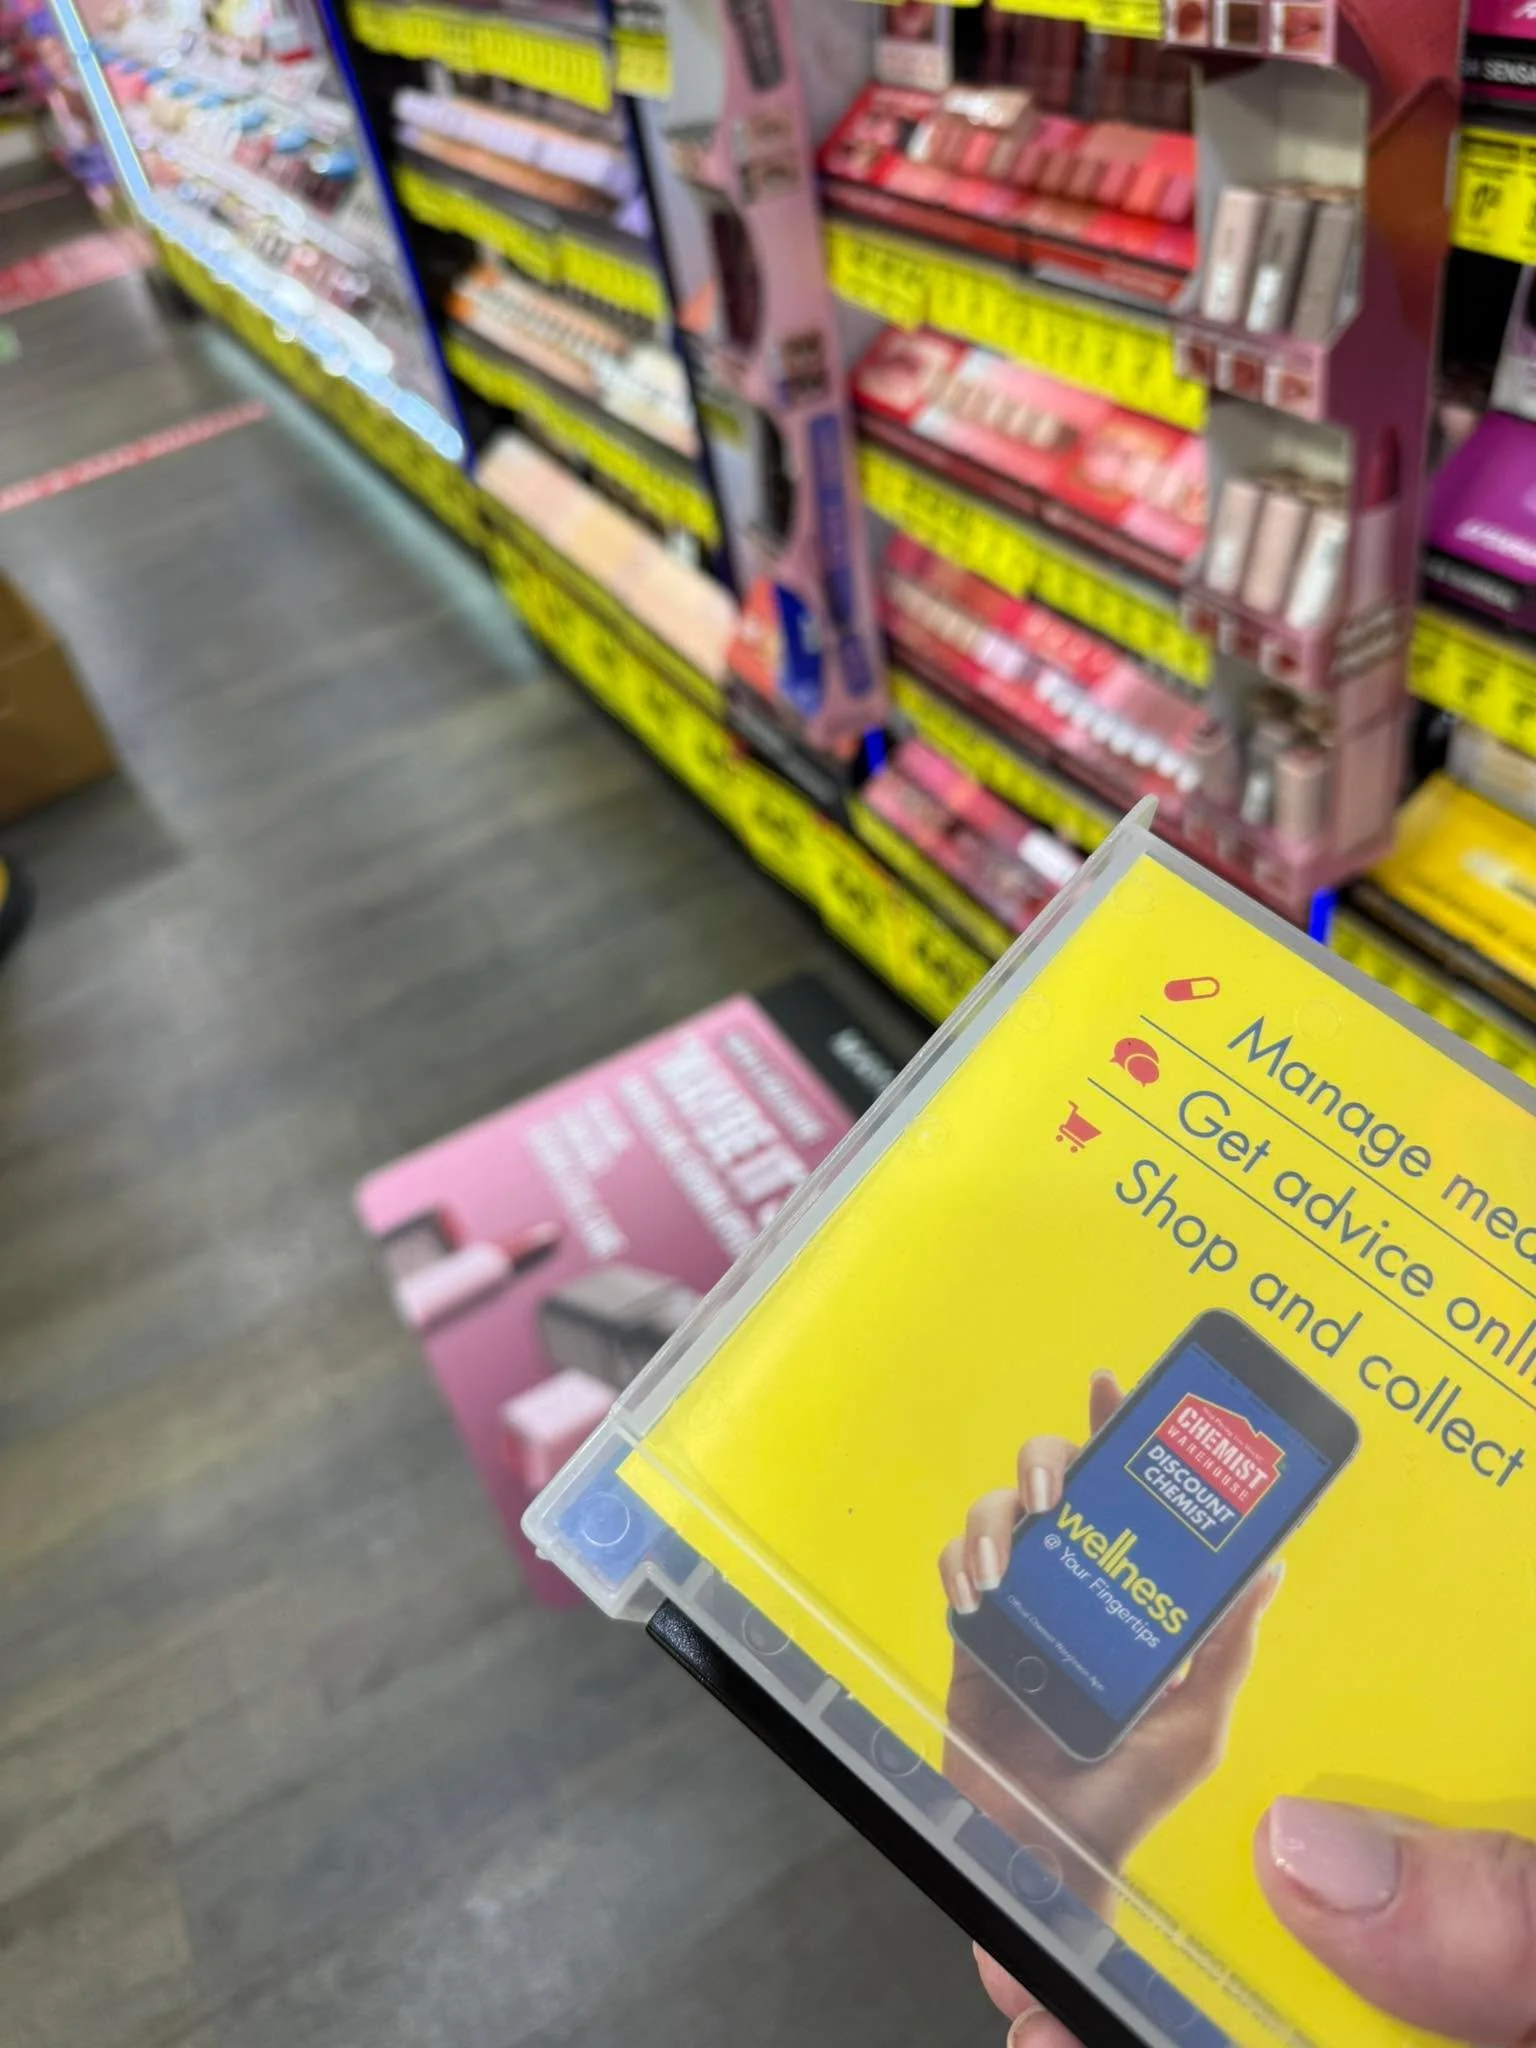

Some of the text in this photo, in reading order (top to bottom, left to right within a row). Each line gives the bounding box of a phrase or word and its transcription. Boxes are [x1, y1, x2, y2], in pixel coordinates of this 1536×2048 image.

[1228, 1017, 1432, 1178] Manage
[1179, 1090, 1536, 1387] Get advice onli
[1115, 1159, 1239, 1275] Shop
[1249, 1271, 1363, 1358] and
[1358, 1354, 1525, 1487] collect
[1144, 1466, 1217, 1531] CHEMIST
[1147, 1445, 1236, 1523] DISCOUNT
[1167, 1425, 1250, 1502] WAREHOUSE
[1176, 1406, 1268, 1490] CHEMIST
[1043, 1533, 1062, 1550] @
[1059, 1546, 1092, 1580] Your
[1088, 1576, 1161, 1648] Fingertips
[1056, 1502, 1189, 1635] wellness
